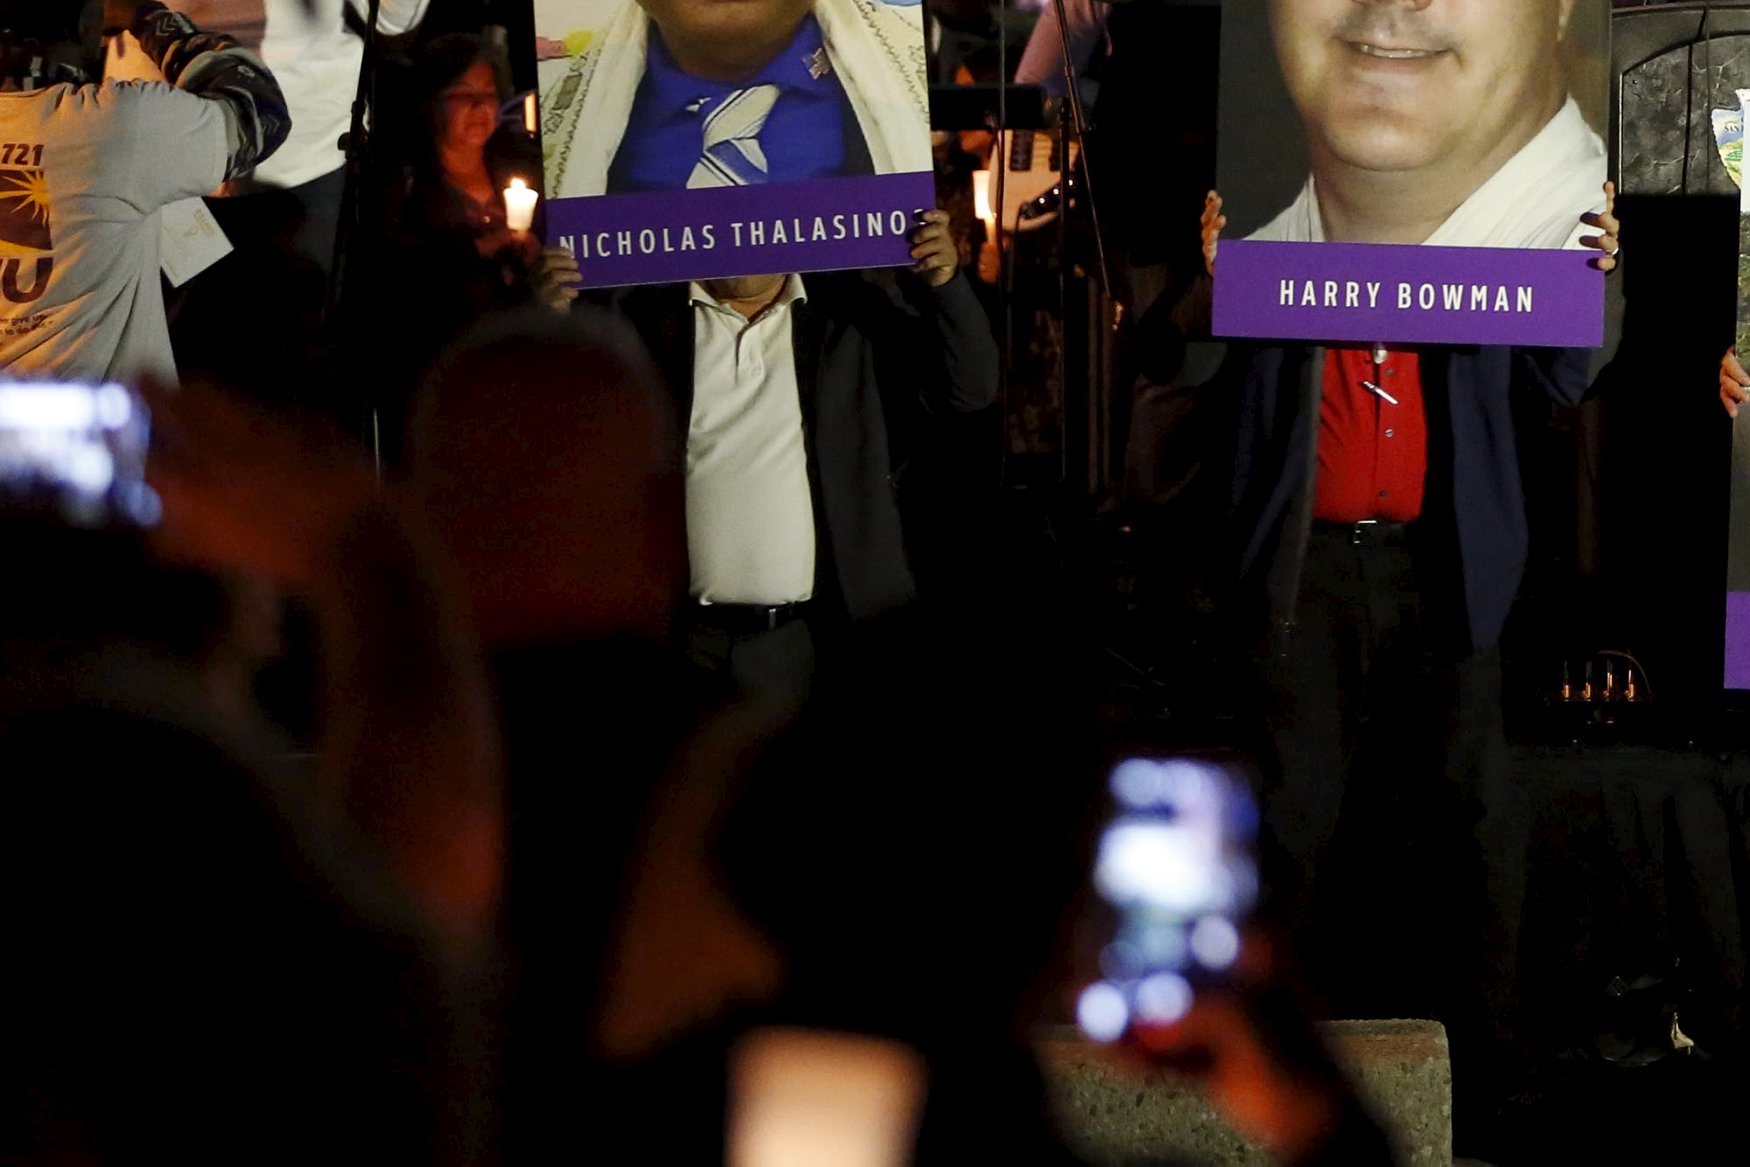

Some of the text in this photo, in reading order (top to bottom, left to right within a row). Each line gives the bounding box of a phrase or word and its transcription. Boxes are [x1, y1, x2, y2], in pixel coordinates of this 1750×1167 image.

[559, 224, 716, 260] NICHOLAS
[1279, 279, 1533, 313] HARRY BOWMAN
